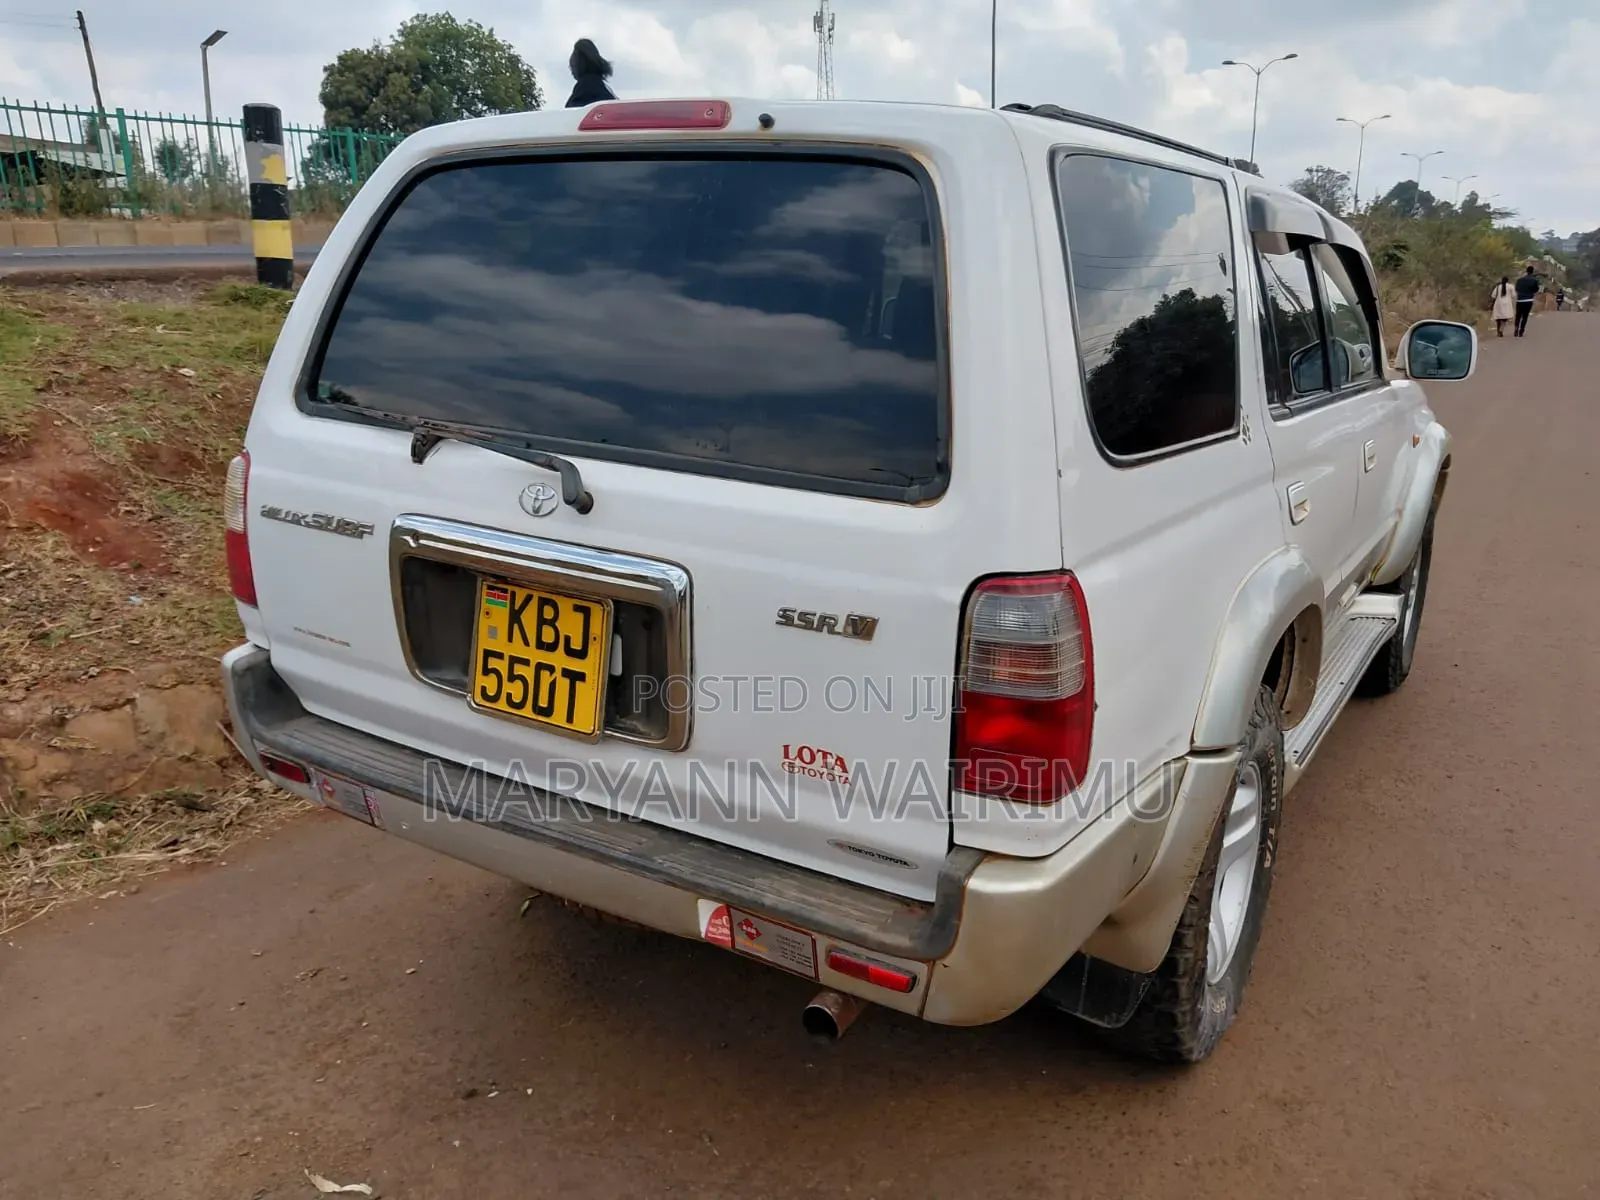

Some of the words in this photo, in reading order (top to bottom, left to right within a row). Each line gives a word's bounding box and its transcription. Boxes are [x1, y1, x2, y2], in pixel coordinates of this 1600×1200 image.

[507, 590, 592, 660] KBJ
[480, 648, 587, 724] 550T
[782, 744, 849, 774] LOTA
[800, 765, 852, 787] TOYOTA
[876, 853, 910, 867] TOYOTA
